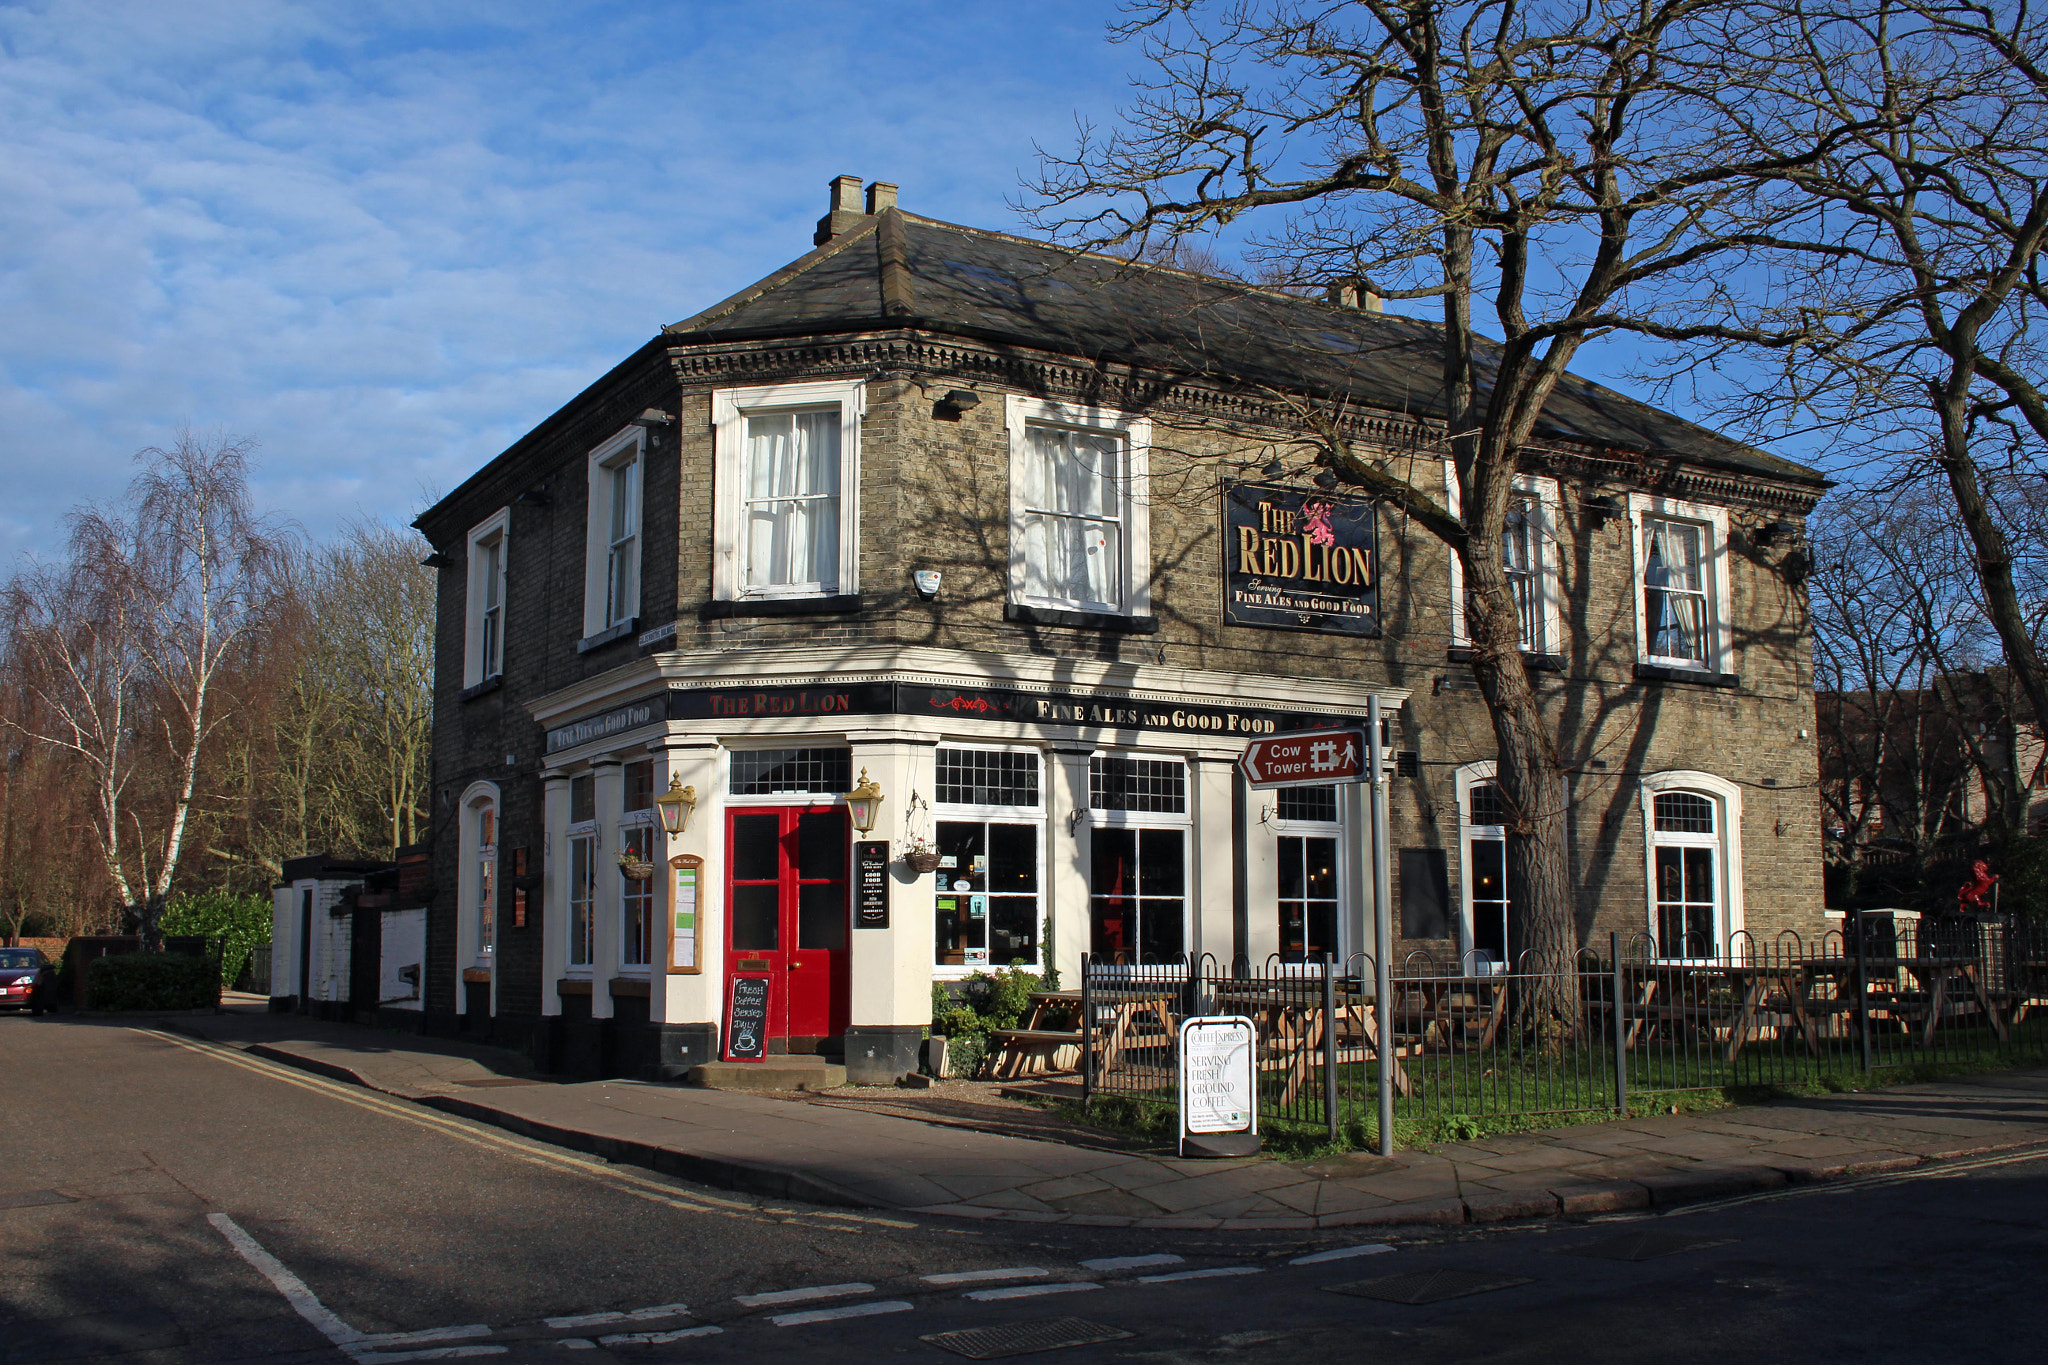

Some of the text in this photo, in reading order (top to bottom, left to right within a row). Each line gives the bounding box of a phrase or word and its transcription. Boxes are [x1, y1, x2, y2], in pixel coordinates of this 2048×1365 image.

[1258, 500, 1297, 536] THE
[1238, 524, 1371, 587] RED LION
[1248, 578, 1282, 596] Serving
[1235, 590, 1371, 614] FINE ALES AND GOOD FOOD
[709, 692, 850, 715] THE RED LION
[605, 715, 626, 733] GOOD
[627, 706, 650, 726] FOOD
[1036, 700, 1276, 734] FINE ALES AND GOOD FOOD
[1270, 744, 1301, 758] Cow
[1265, 761, 1307, 775] Tower
[739, 982, 764, 995] FRESH
[734, 996, 762, 1006] COFFEE
[734, 1007, 763, 1018] SERVED
[1191, 1055, 1232, 1068] SERVING
[1192, 1069, 1220, 1081] FRESH
[1192, 1082, 1235, 1095] GROUND
[1192, 1096, 1227, 1108] COFFEE
